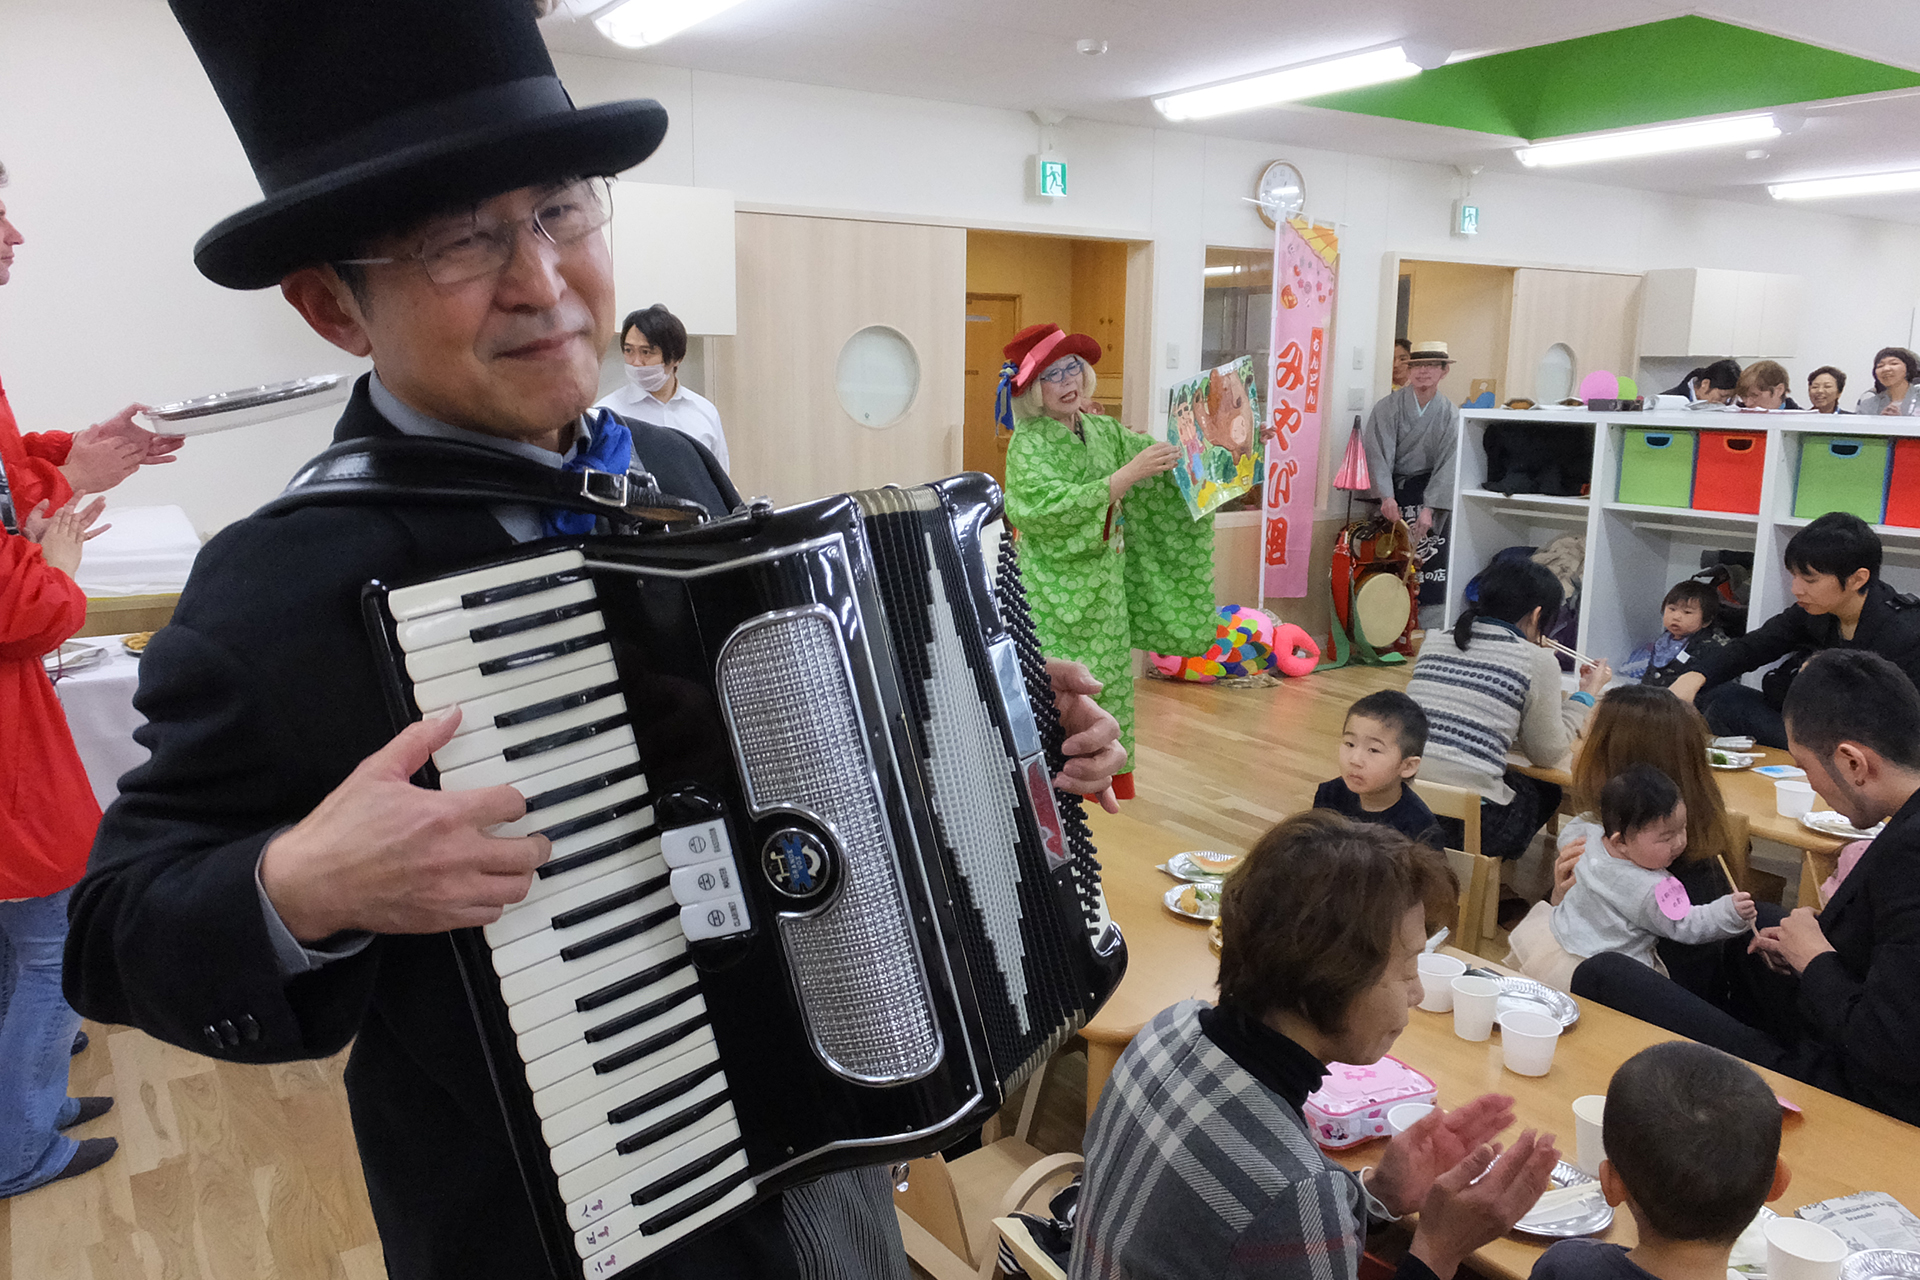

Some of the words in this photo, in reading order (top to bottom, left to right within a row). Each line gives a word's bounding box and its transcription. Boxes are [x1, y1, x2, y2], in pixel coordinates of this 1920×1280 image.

[1307, 337, 1320, 405] ちんどん
[1265, 340, 1305, 566] みやび組
